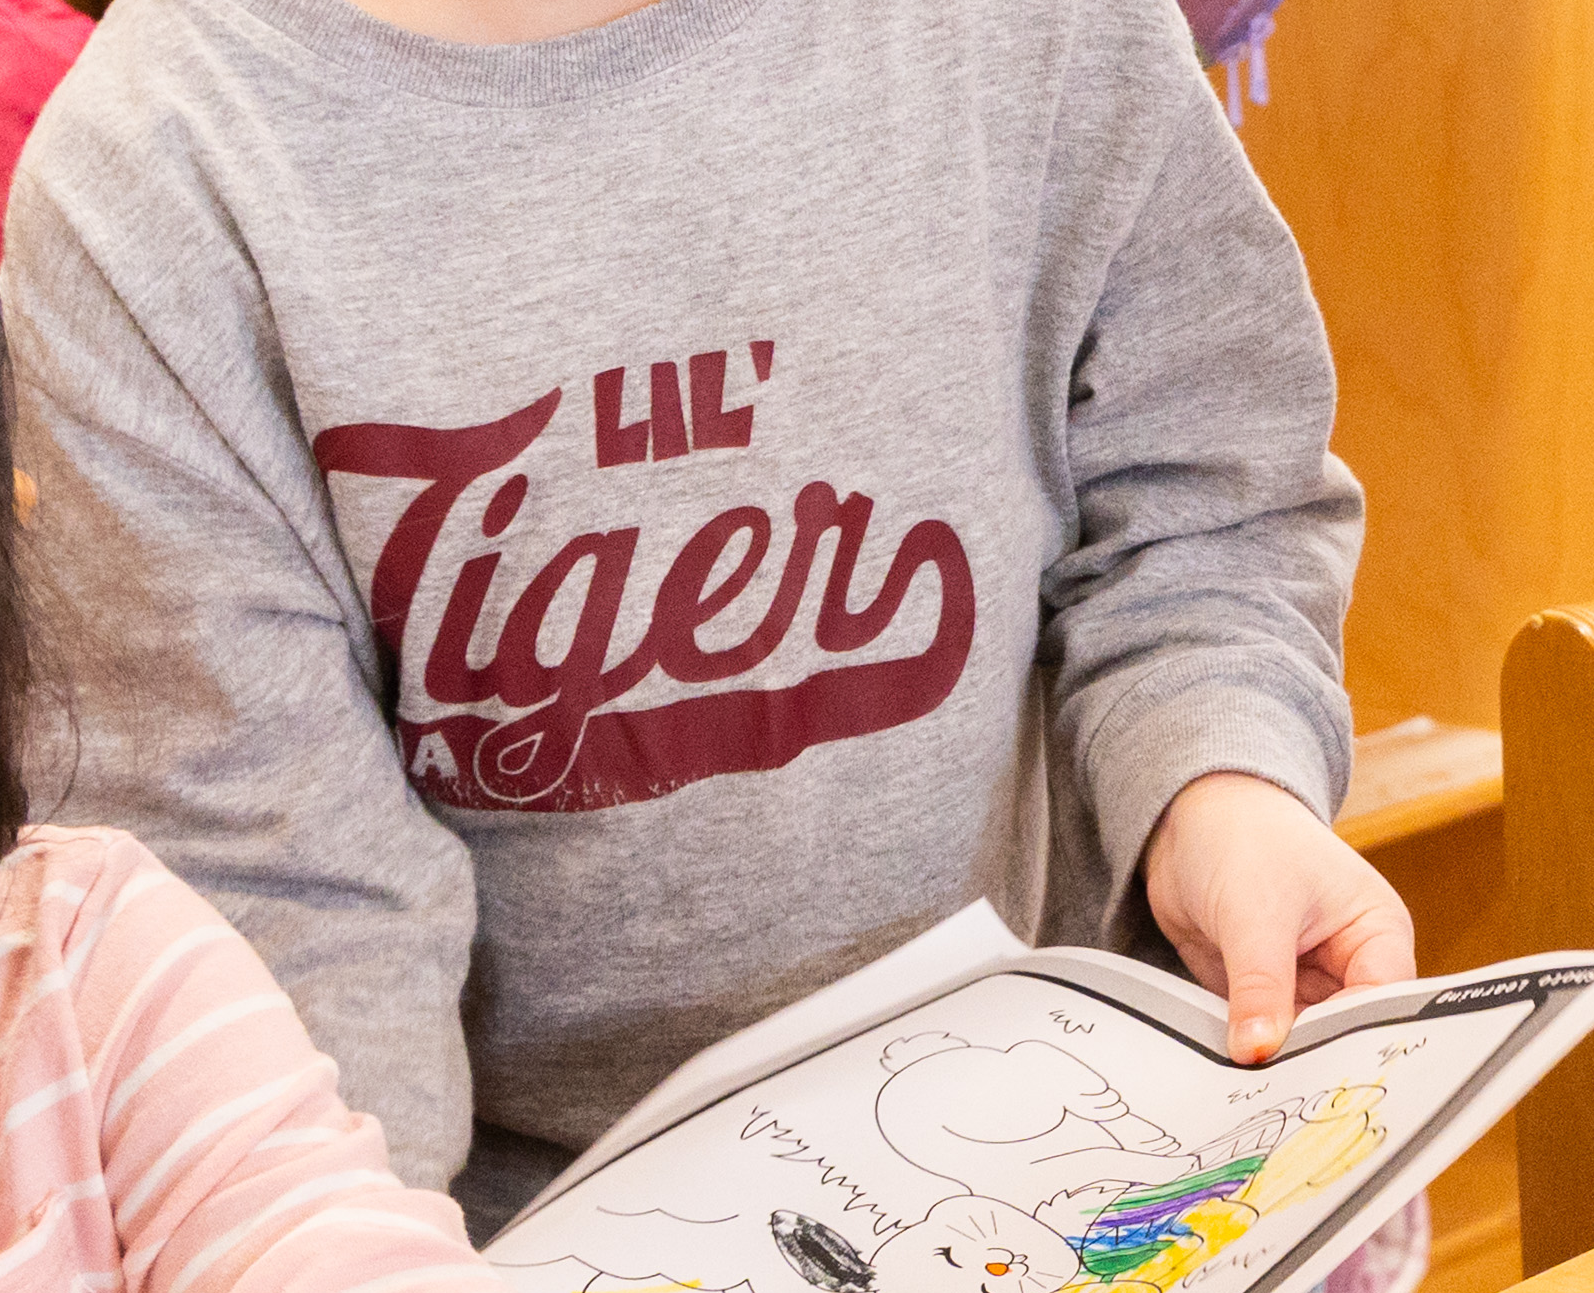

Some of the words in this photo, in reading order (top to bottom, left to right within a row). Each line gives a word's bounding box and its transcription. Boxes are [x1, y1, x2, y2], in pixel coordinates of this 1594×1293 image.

[593, 339, 775, 468] LIL'
[312, 386, 976, 812] Tiger
[1434, 978, 1530, 1005] Learning
